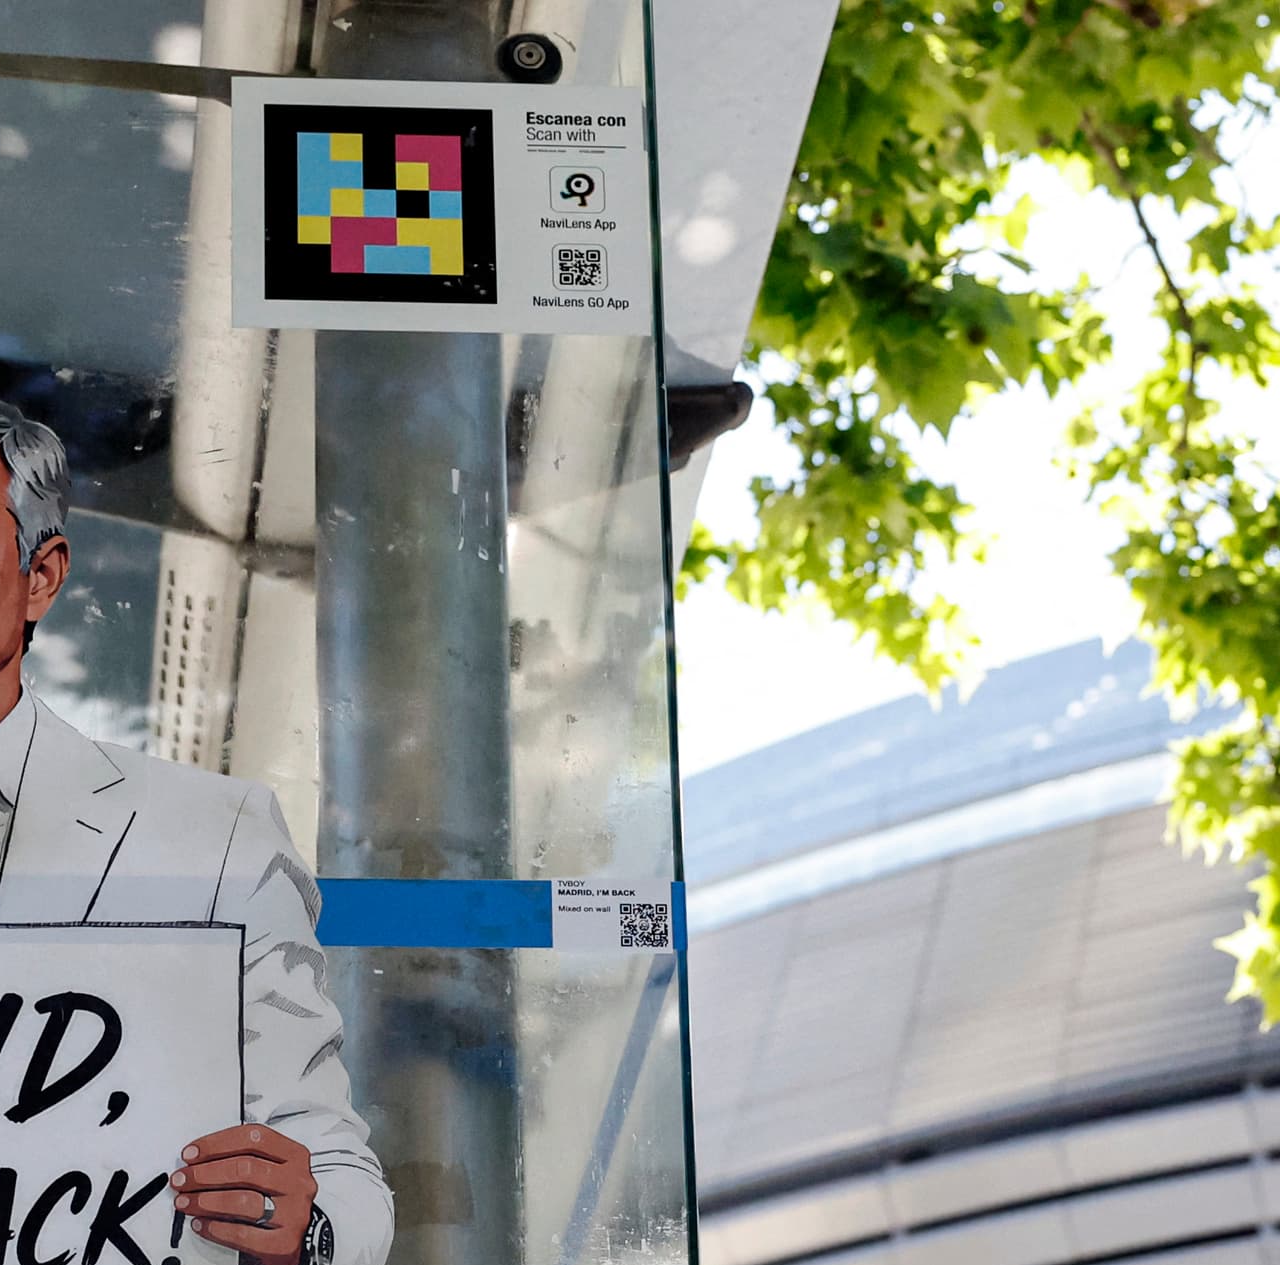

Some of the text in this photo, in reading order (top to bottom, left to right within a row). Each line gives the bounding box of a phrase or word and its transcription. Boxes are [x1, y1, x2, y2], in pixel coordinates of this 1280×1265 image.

[526, 112, 627, 128] Escanea con
[526, 126, 596, 143] Scan with
[540, 217, 617, 232] NaviLens App
[532, 295, 630, 311] NaviLens GO App
[558, 889, 595, 897] MADRID,
